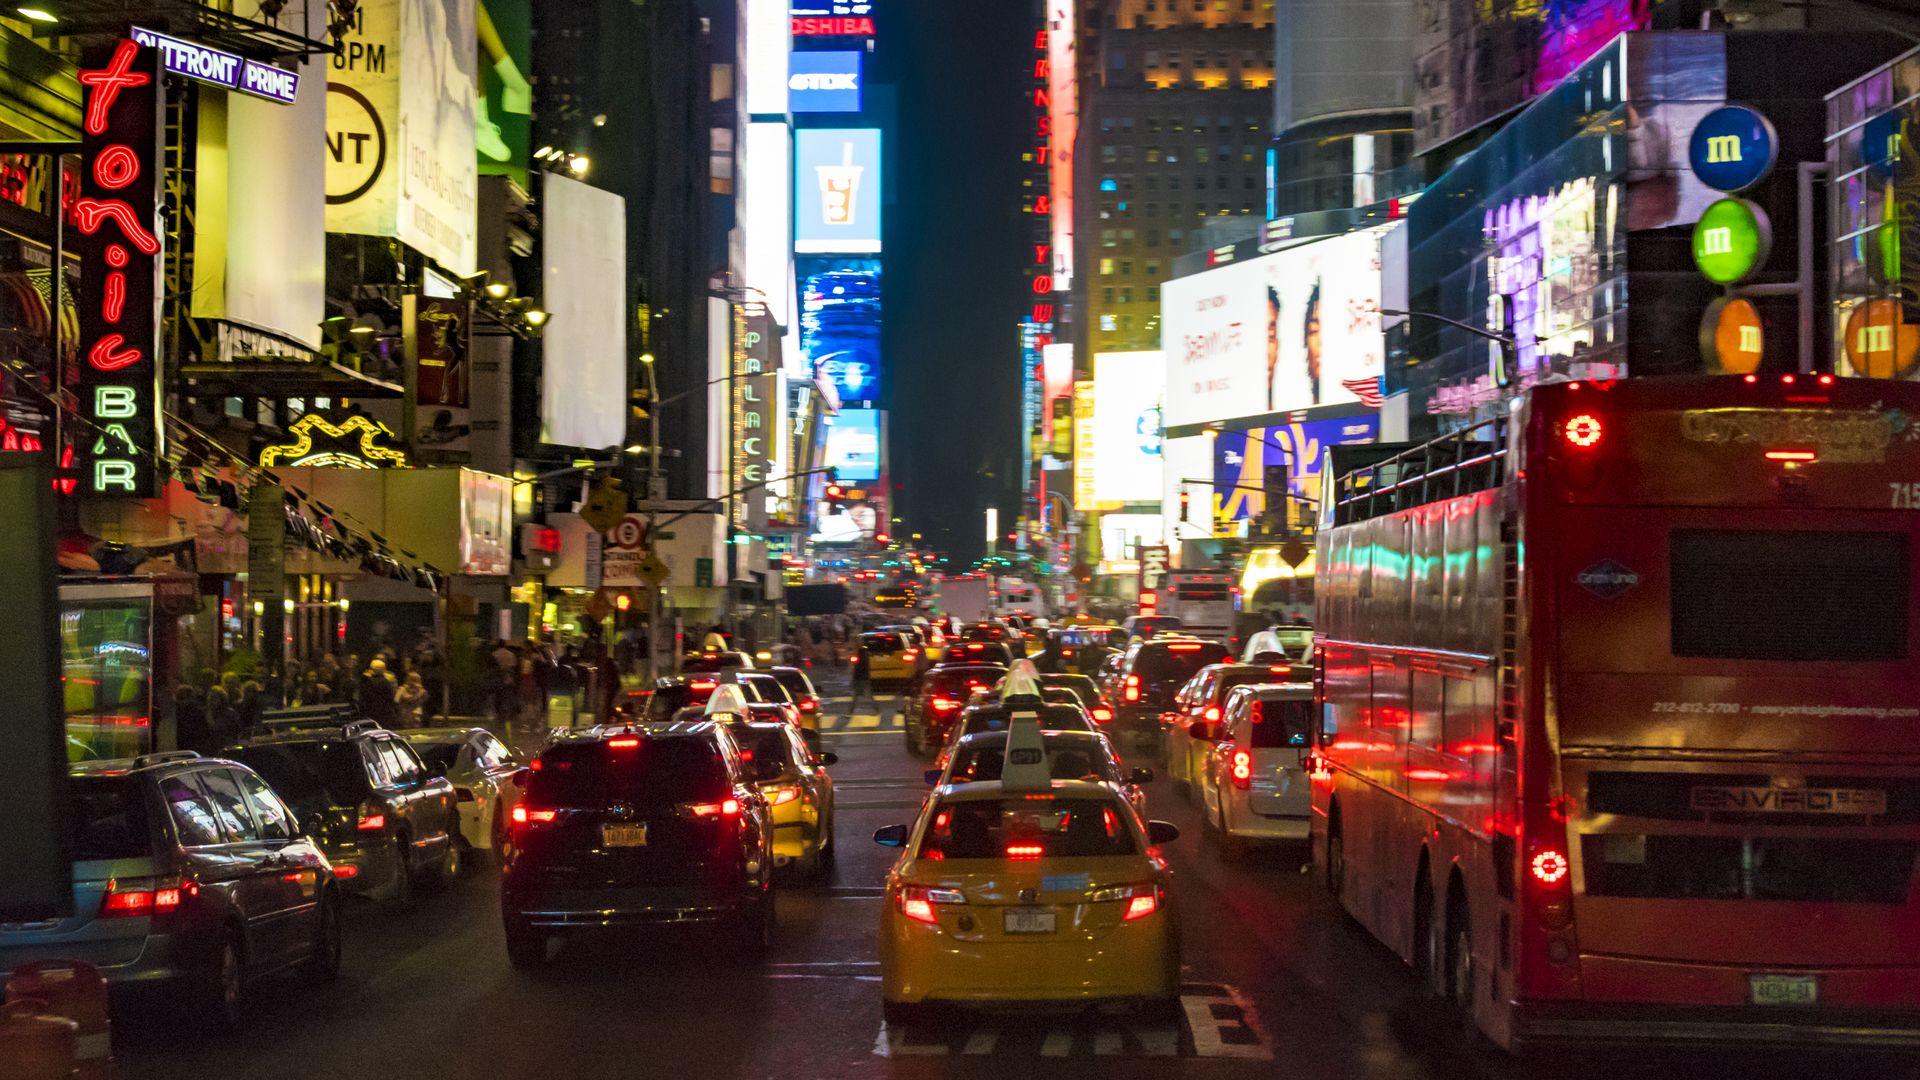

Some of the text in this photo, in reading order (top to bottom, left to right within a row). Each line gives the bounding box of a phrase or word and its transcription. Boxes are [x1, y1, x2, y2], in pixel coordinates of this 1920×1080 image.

[136, 33, 295, 101] TFRONT PRIME
[1033, 30, 1050, 165] ERNST
[1706, 134, 1742, 164] m
[1703, 225, 1733, 256] m
[1739, 324, 1761, 353] m
[94, 385, 138, 492] BAR
[744, 331, 761, 482] PALACE
